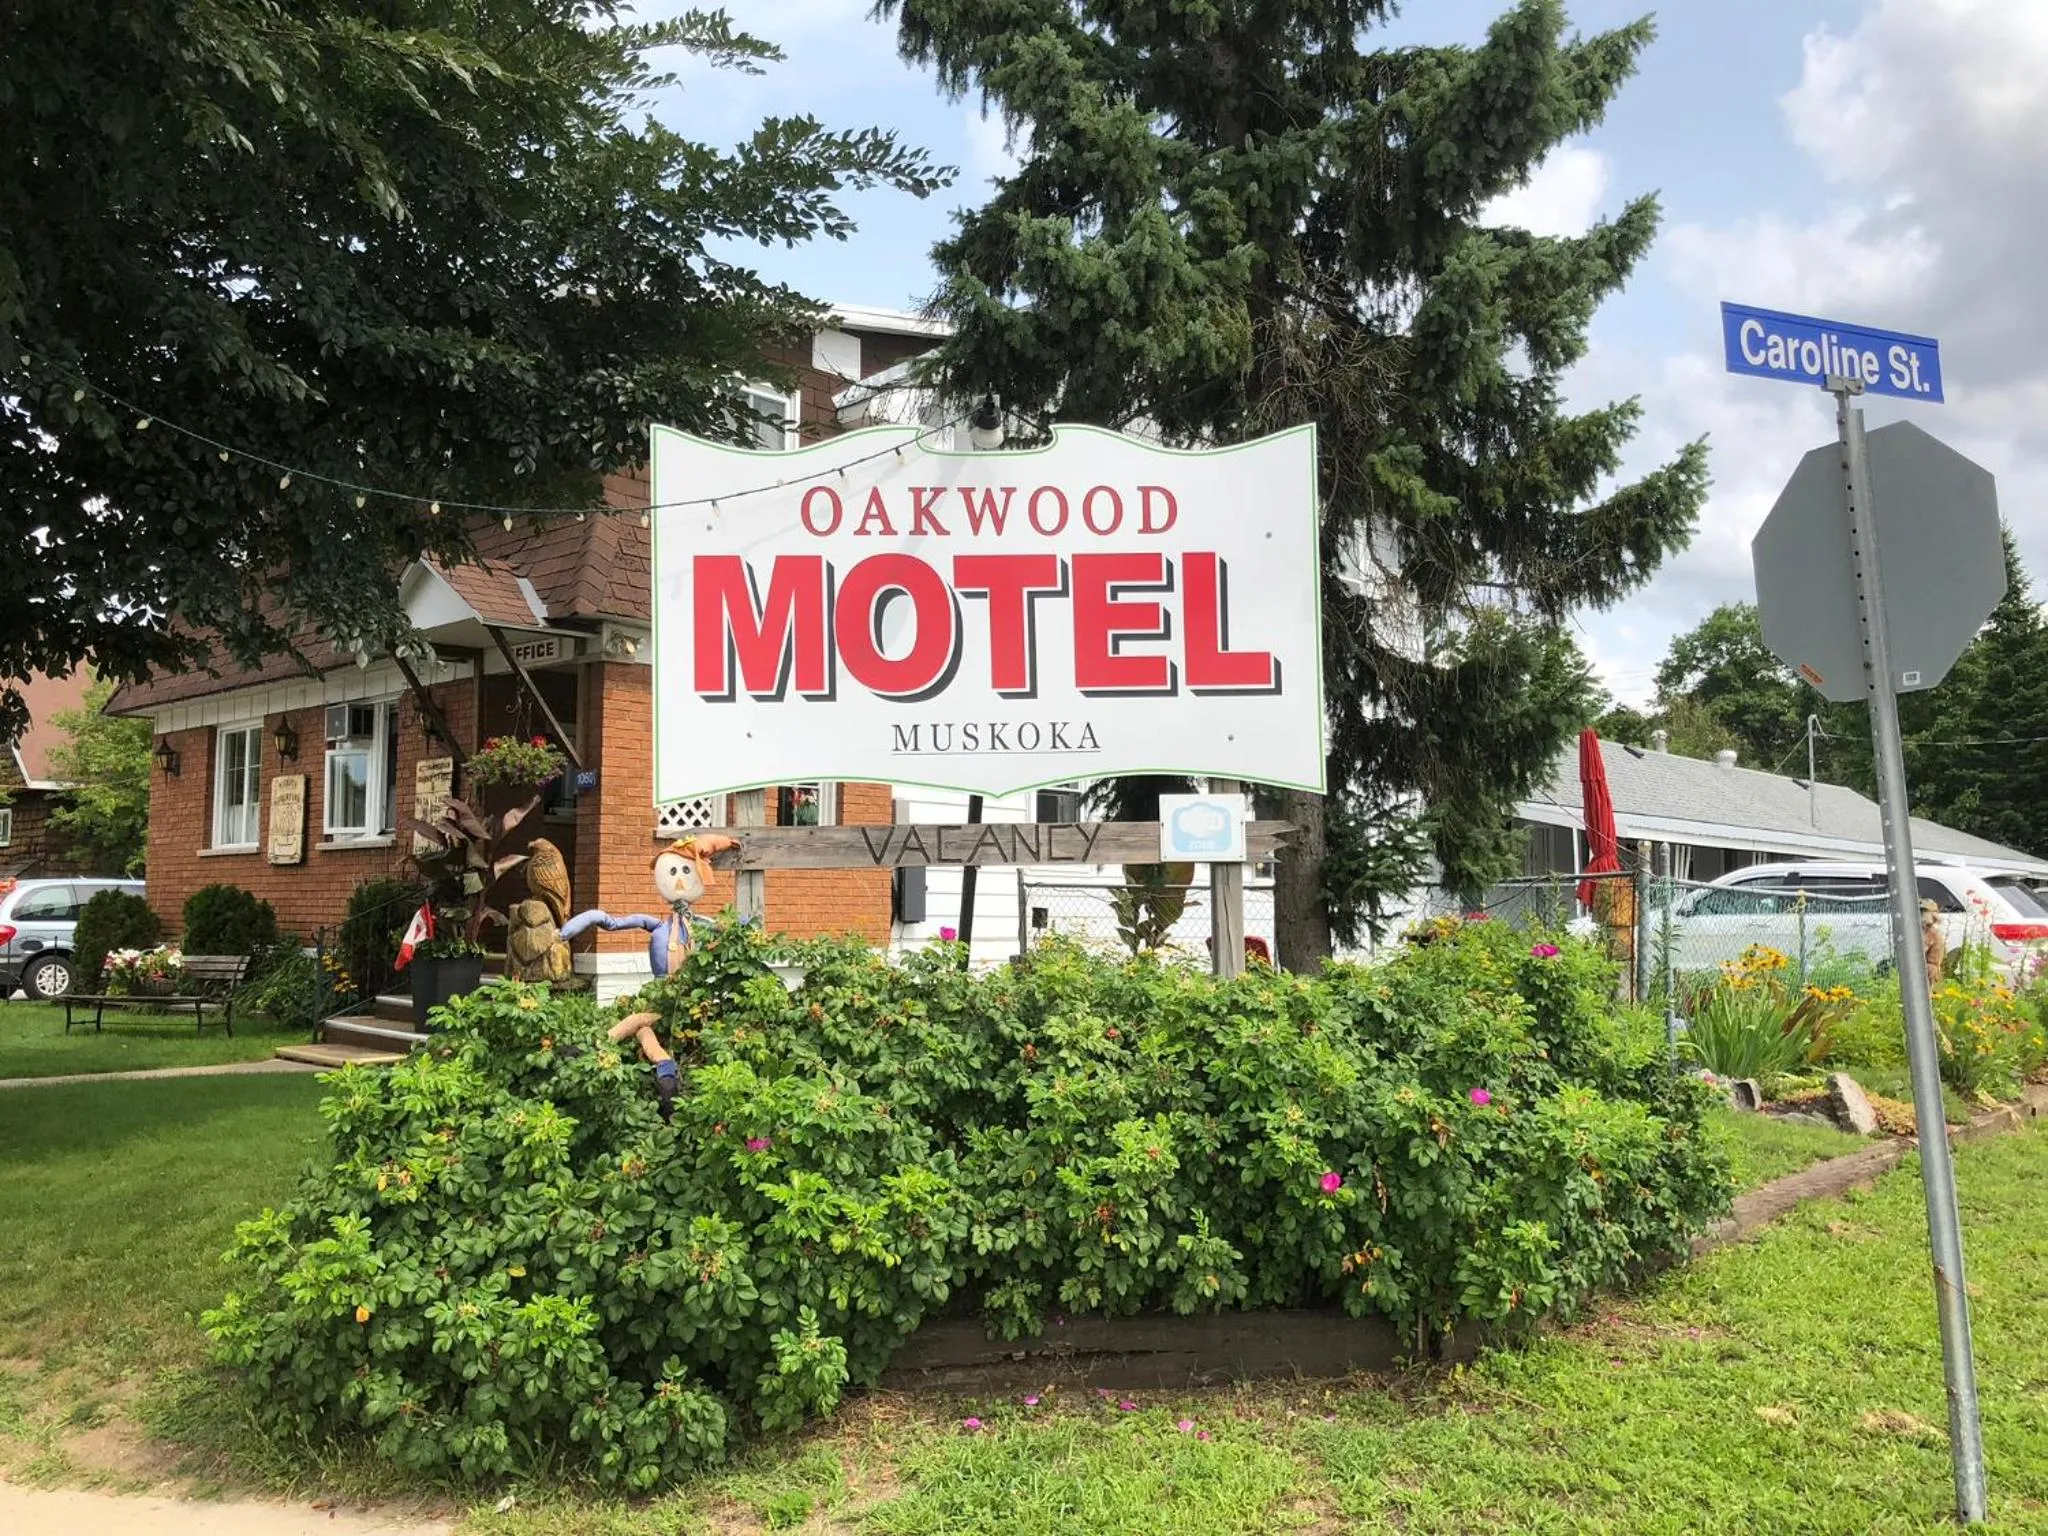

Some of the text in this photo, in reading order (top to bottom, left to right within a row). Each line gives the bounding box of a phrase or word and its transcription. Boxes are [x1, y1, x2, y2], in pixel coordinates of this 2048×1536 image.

[1740, 319, 1931, 393] Caroline St.
[801, 485, 1178, 537] OAKWOOD
[515, 640, 554, 660] FFICE
[693, 551, 1283, 703] MOTEL
[892, 722, 1101, 751] MUSKOKA
[861, 824, 1102, 864] VACANCY
